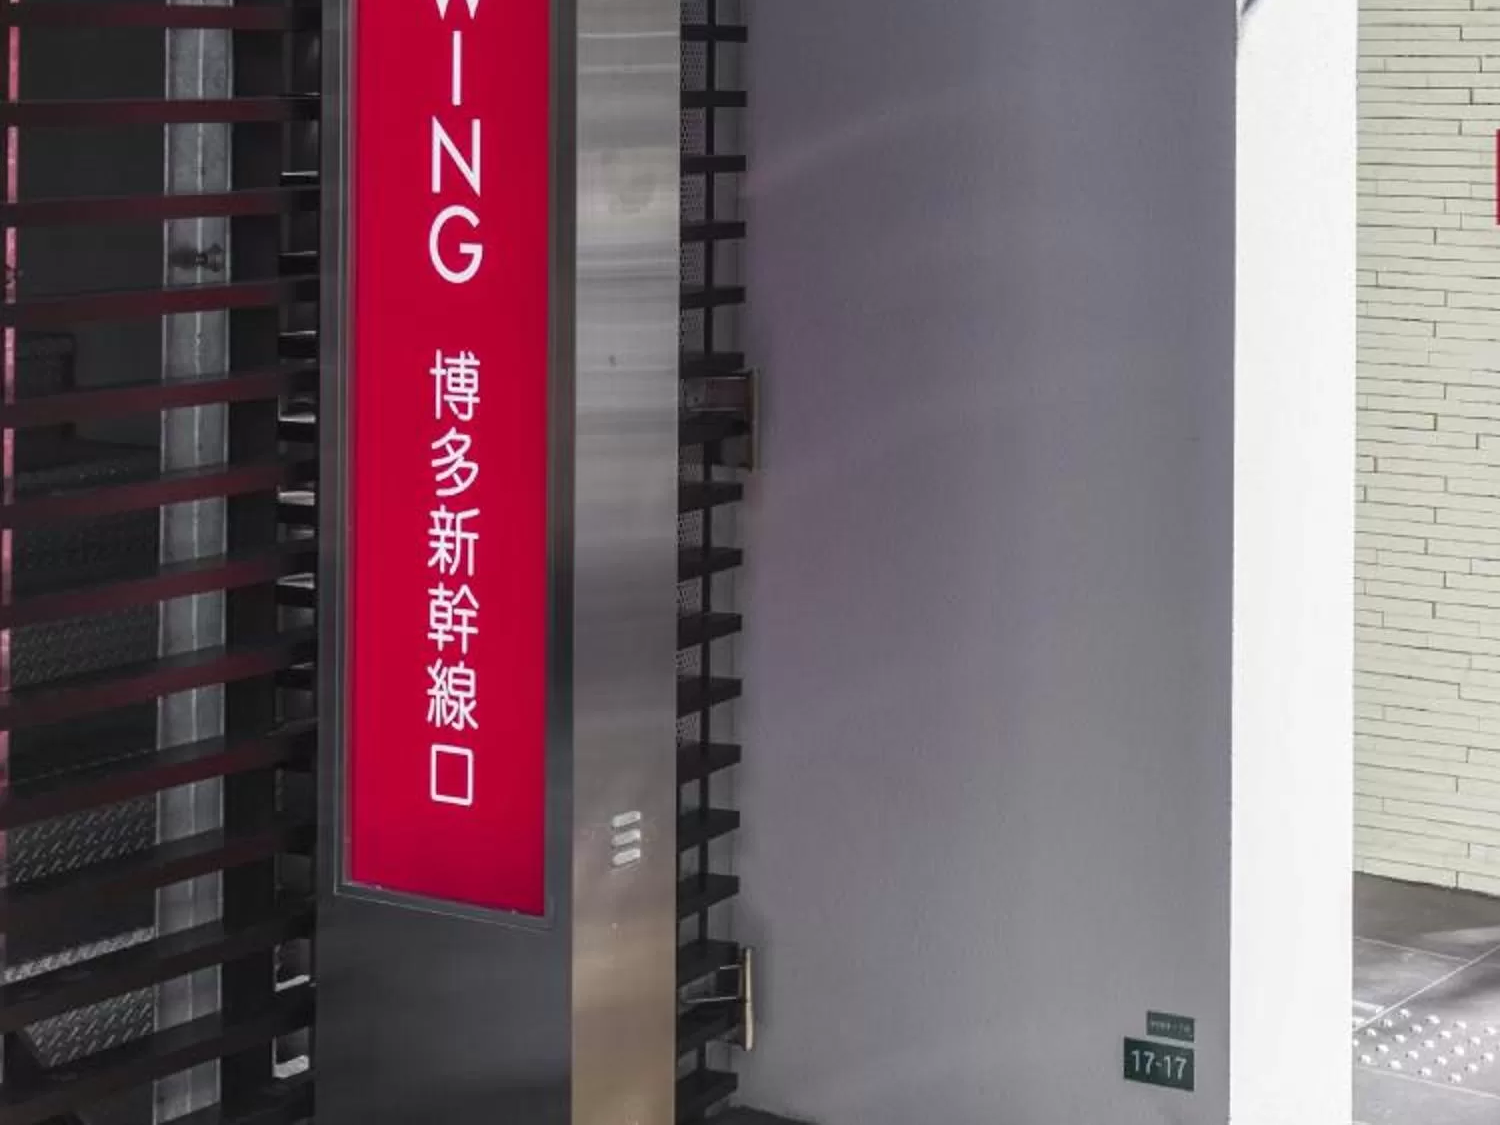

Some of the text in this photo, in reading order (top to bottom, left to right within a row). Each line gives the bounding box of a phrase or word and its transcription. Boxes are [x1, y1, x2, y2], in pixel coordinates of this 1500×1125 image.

[427, 349, 481, 806] 博多新幹線口
[1131, 1048, 1187, 1080] 17-17
